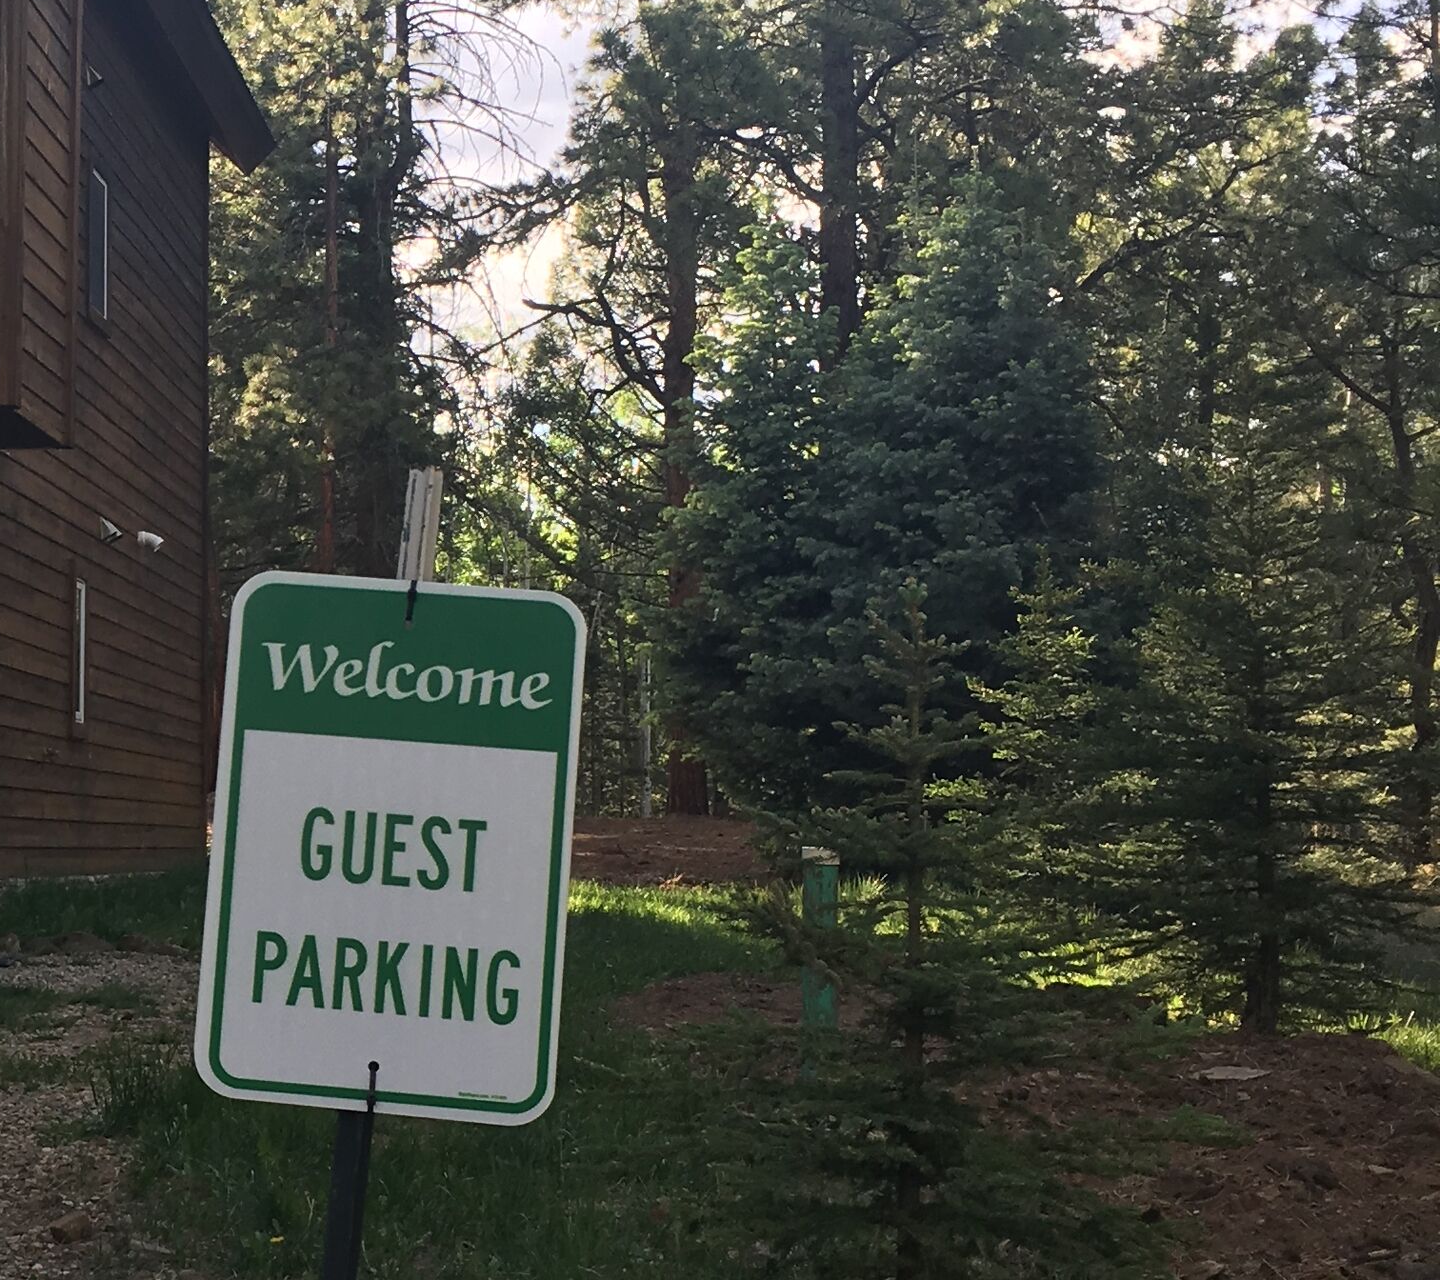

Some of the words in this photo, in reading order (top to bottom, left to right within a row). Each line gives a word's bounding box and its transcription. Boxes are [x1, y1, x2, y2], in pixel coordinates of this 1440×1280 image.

[262, 641, 553, 710] Welcome
[300, 806, 488, 893] GUEST
[251, 930, 521, 1026] PARKING
